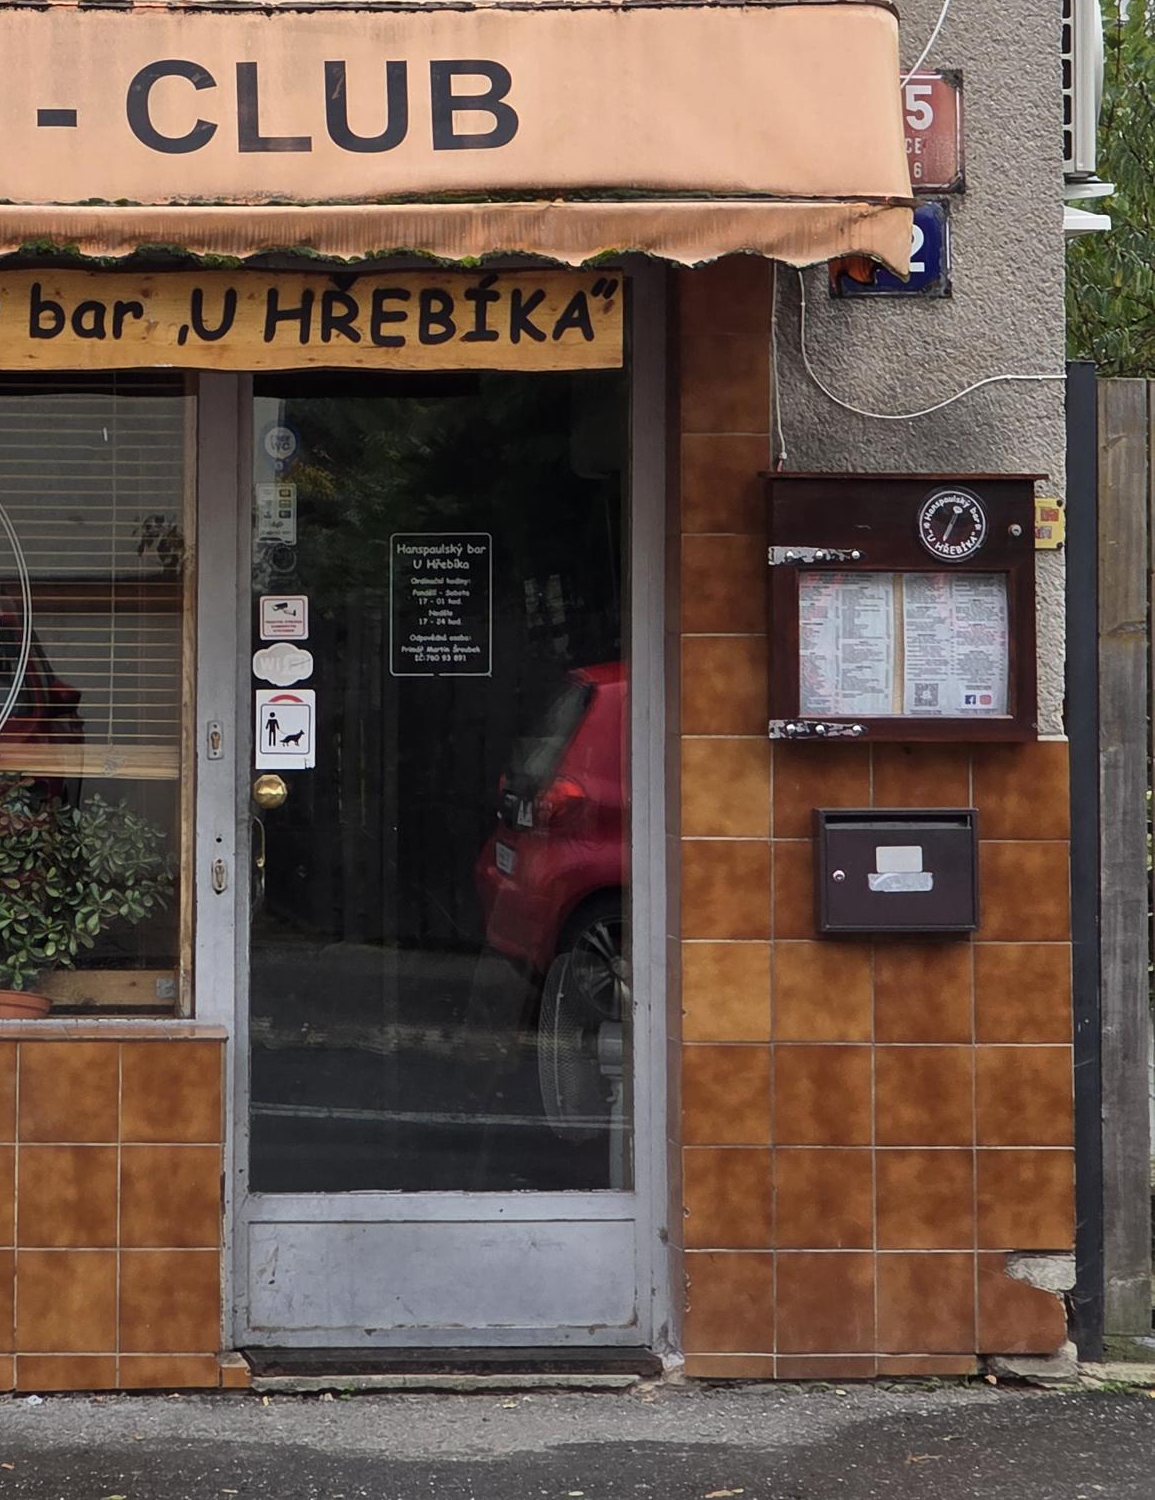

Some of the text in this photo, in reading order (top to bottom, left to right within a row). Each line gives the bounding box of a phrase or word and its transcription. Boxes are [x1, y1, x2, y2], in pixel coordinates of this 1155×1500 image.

[125, 59, 520, 155] CLUB
[913, 162, 923, 178] 6
[29, 282, 144, 340] bar
[396, 543, 487, 557] Hanspaulský bar
[412, 559, 422, 569] U
